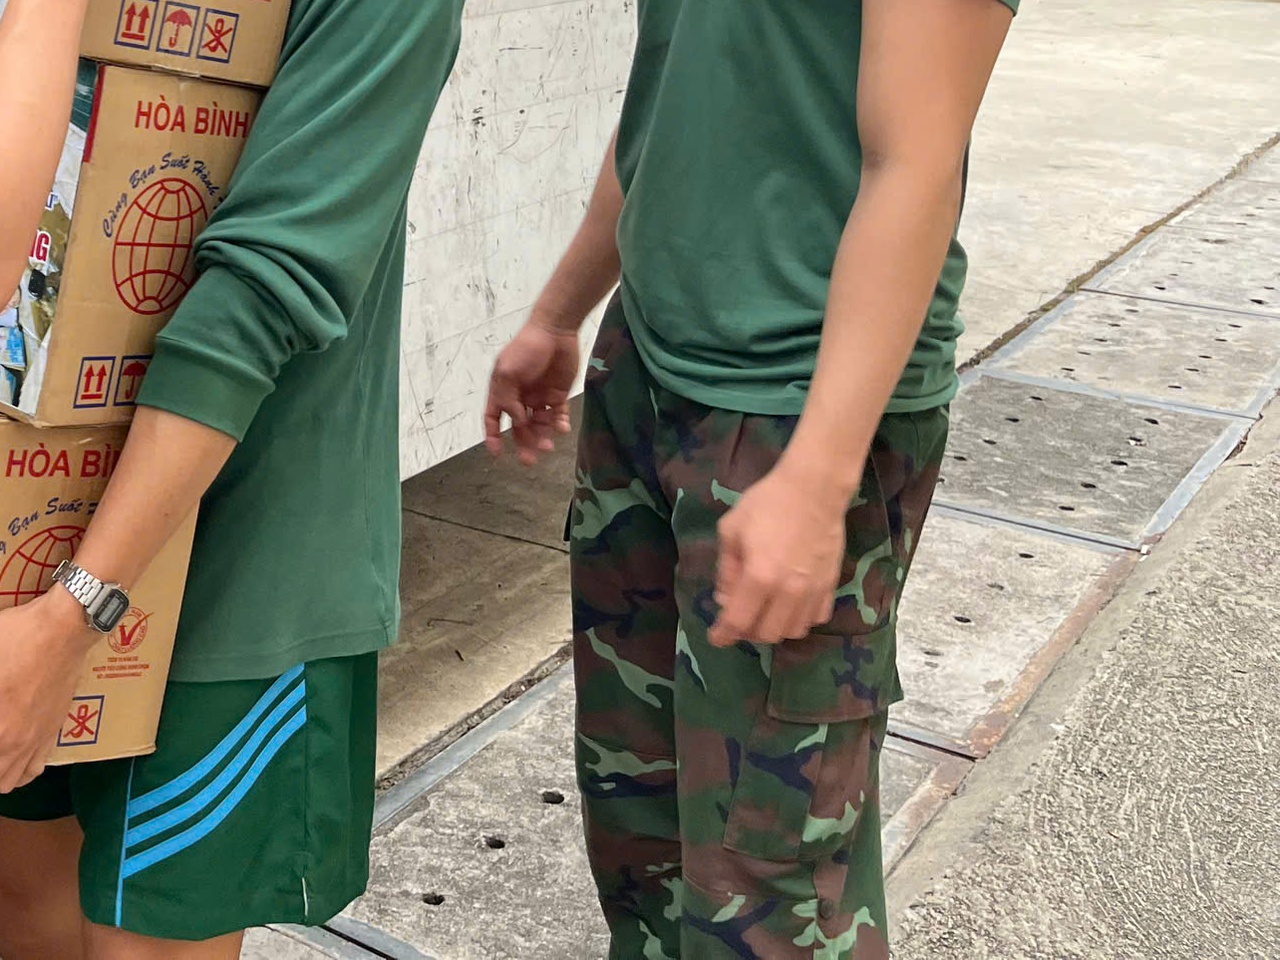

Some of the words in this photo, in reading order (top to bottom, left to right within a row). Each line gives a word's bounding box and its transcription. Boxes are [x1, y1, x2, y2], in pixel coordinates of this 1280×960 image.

[135, 95, 185, 133] HÒA
[194, 101, 251, 139] BÌNH
[103, 192, 127, 238] Cùng
[129, 167, 156, 189] Bạn
[161, 152, 190, 171] Suốt
[192, 160, 221, 196] Hành
[5, 442, 70, 478] HÒA
[8, 510, 40, 537] Bạn
[45, 497, 83, 516] Suốt
